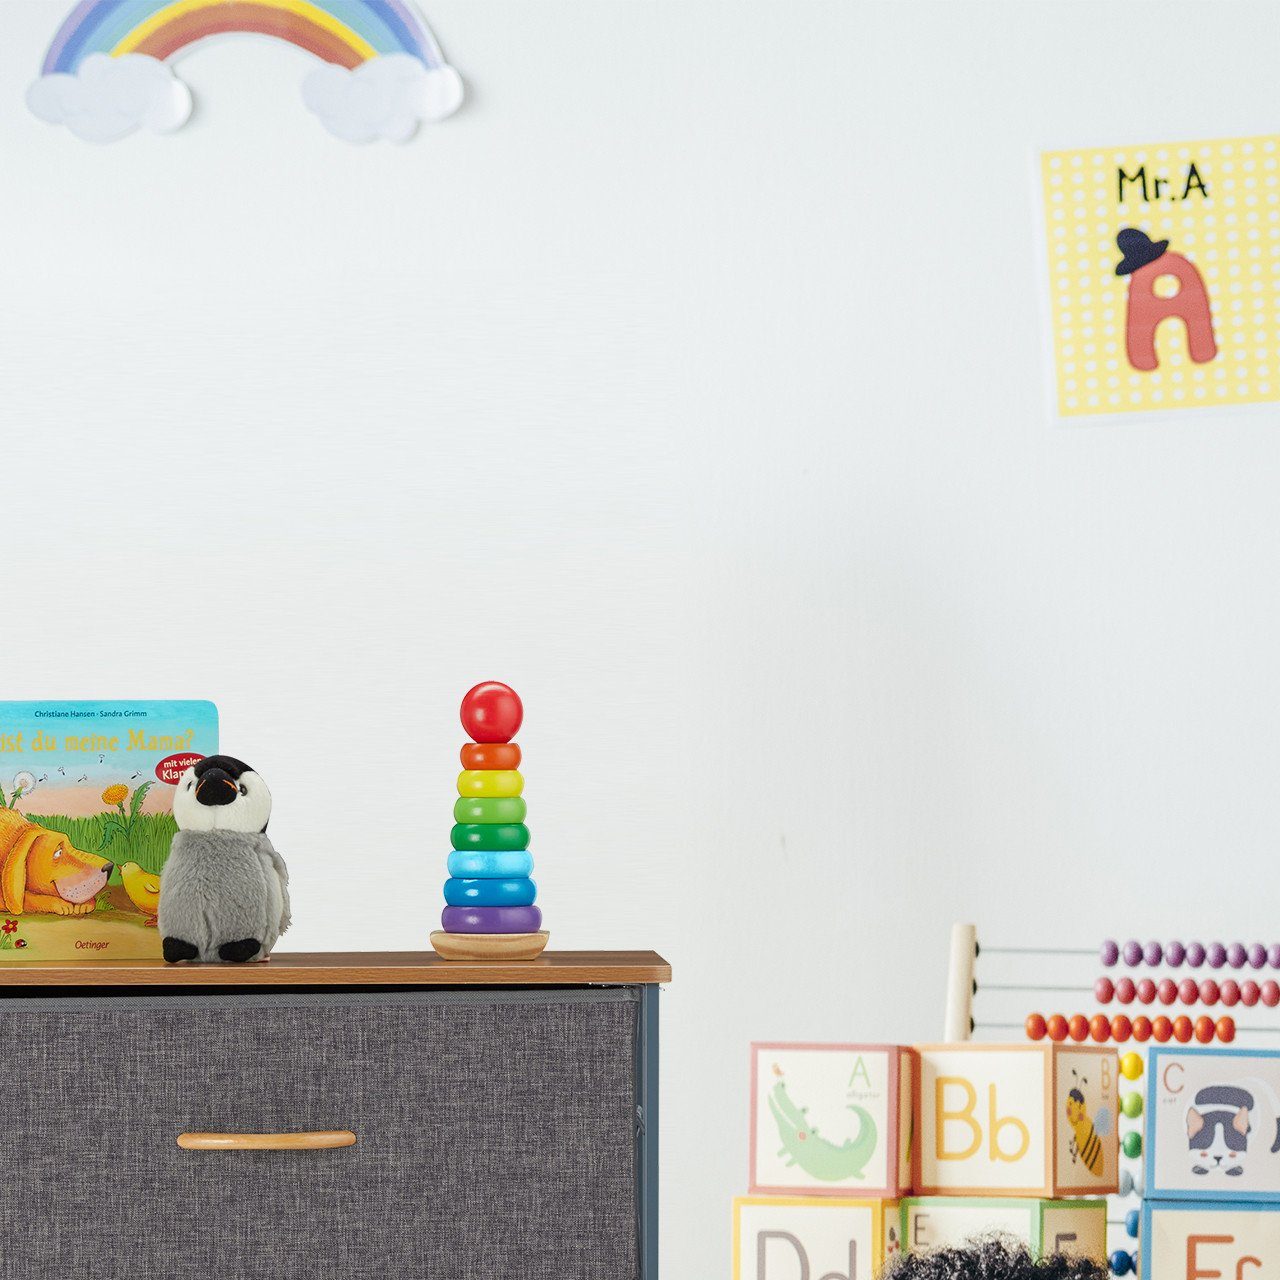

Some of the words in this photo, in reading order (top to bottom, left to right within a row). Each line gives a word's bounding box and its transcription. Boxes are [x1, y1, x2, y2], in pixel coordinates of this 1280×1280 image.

[1117, 162, 1209, 203] Mr.A
[1126, 249, 1219, 373] A
[34, 710, 69, 718] Christiane
[70, 710, 96, 718] Hansen
[99, 710, 123, 718] Sandra
[123, 710, 148, 718] Grimm
[31, 729, 57, 752] du
[65, 733, 119, 752] meine
[126, 728, 194, 751] Mama?
[163, 759, 178, 768] mit
[75, 940, 110, 951] Oetinger
[847, 1055, 872, 1088] A
[1100, 1057, 1111, 1091] B
[1162, 1061, 1186, 1095] C
[934, 1075, 1030, 1163] Bb
[914, 1213, 931, 1246] E
